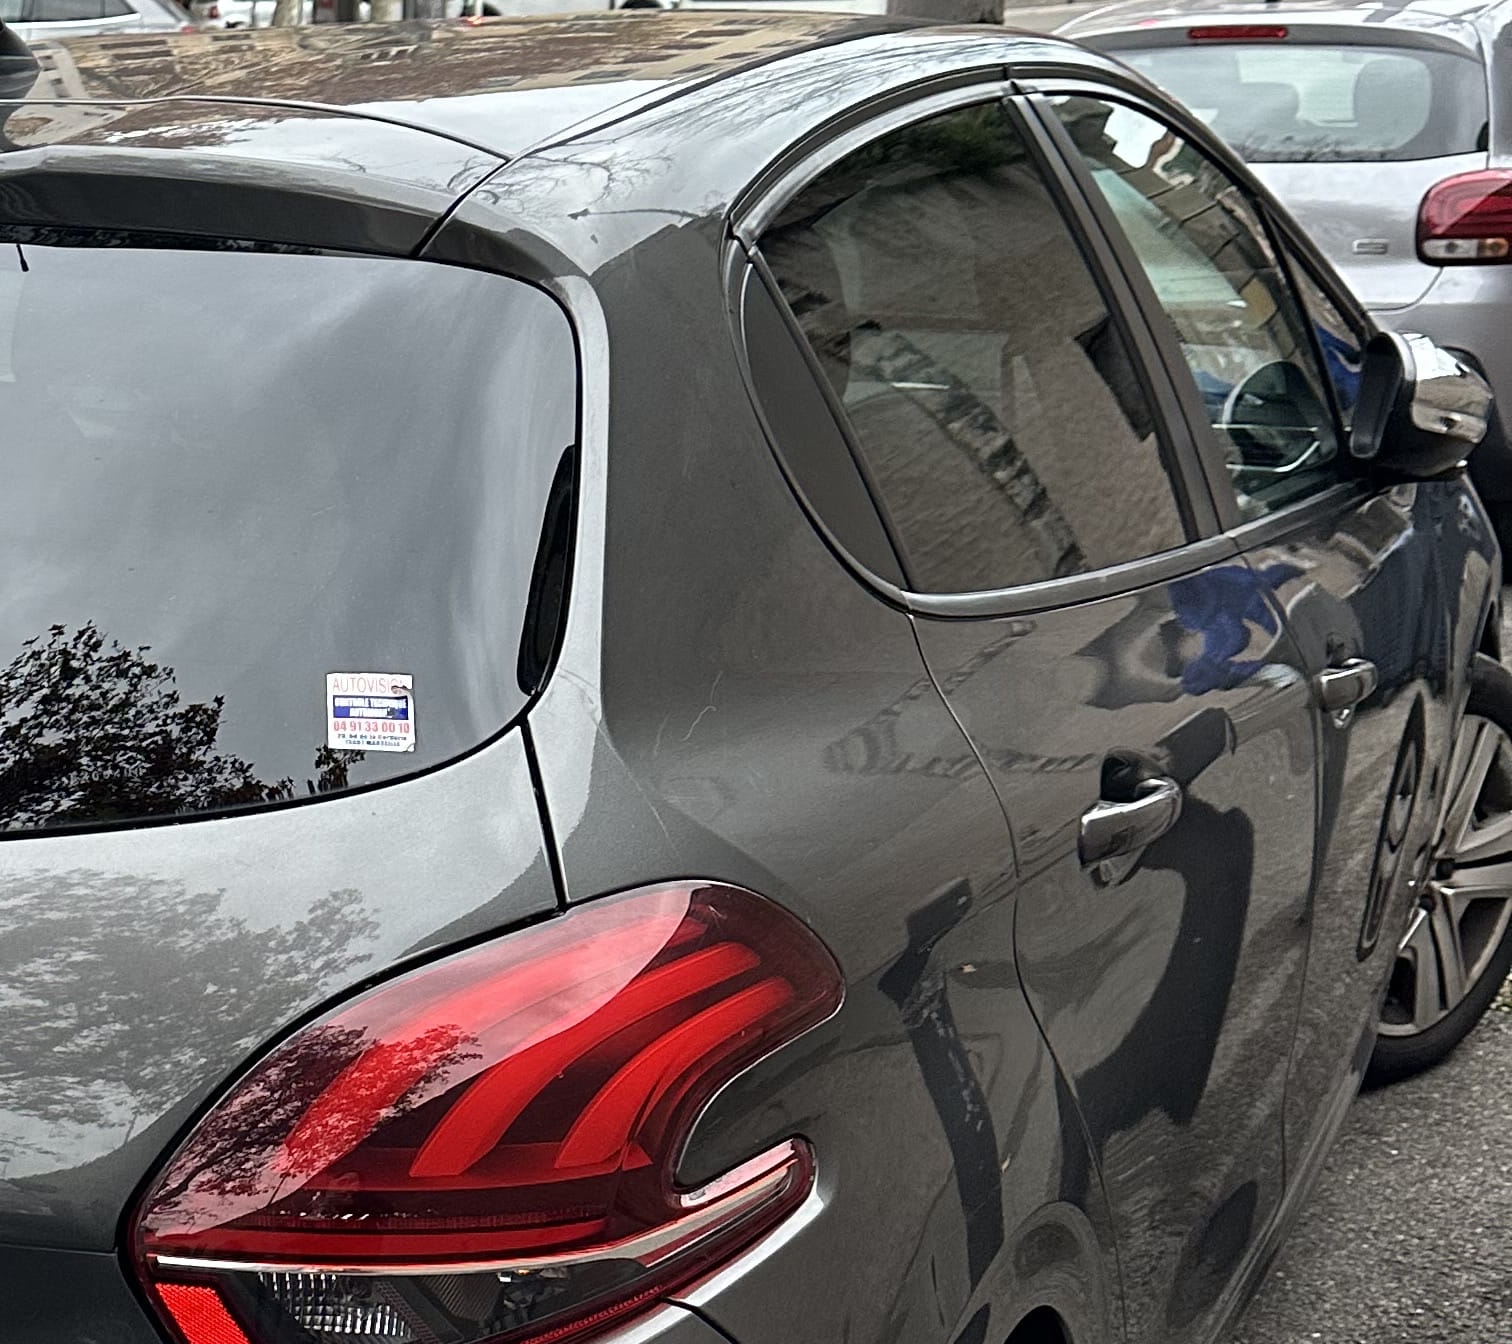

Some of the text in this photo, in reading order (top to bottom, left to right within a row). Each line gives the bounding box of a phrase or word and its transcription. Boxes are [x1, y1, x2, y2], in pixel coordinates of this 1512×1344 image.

[334, 721, 347, 732] 04
[350, 721, 362, 732] 91
[365, 721, 378, 732] 33
[382, 722, 395, 733] 00
